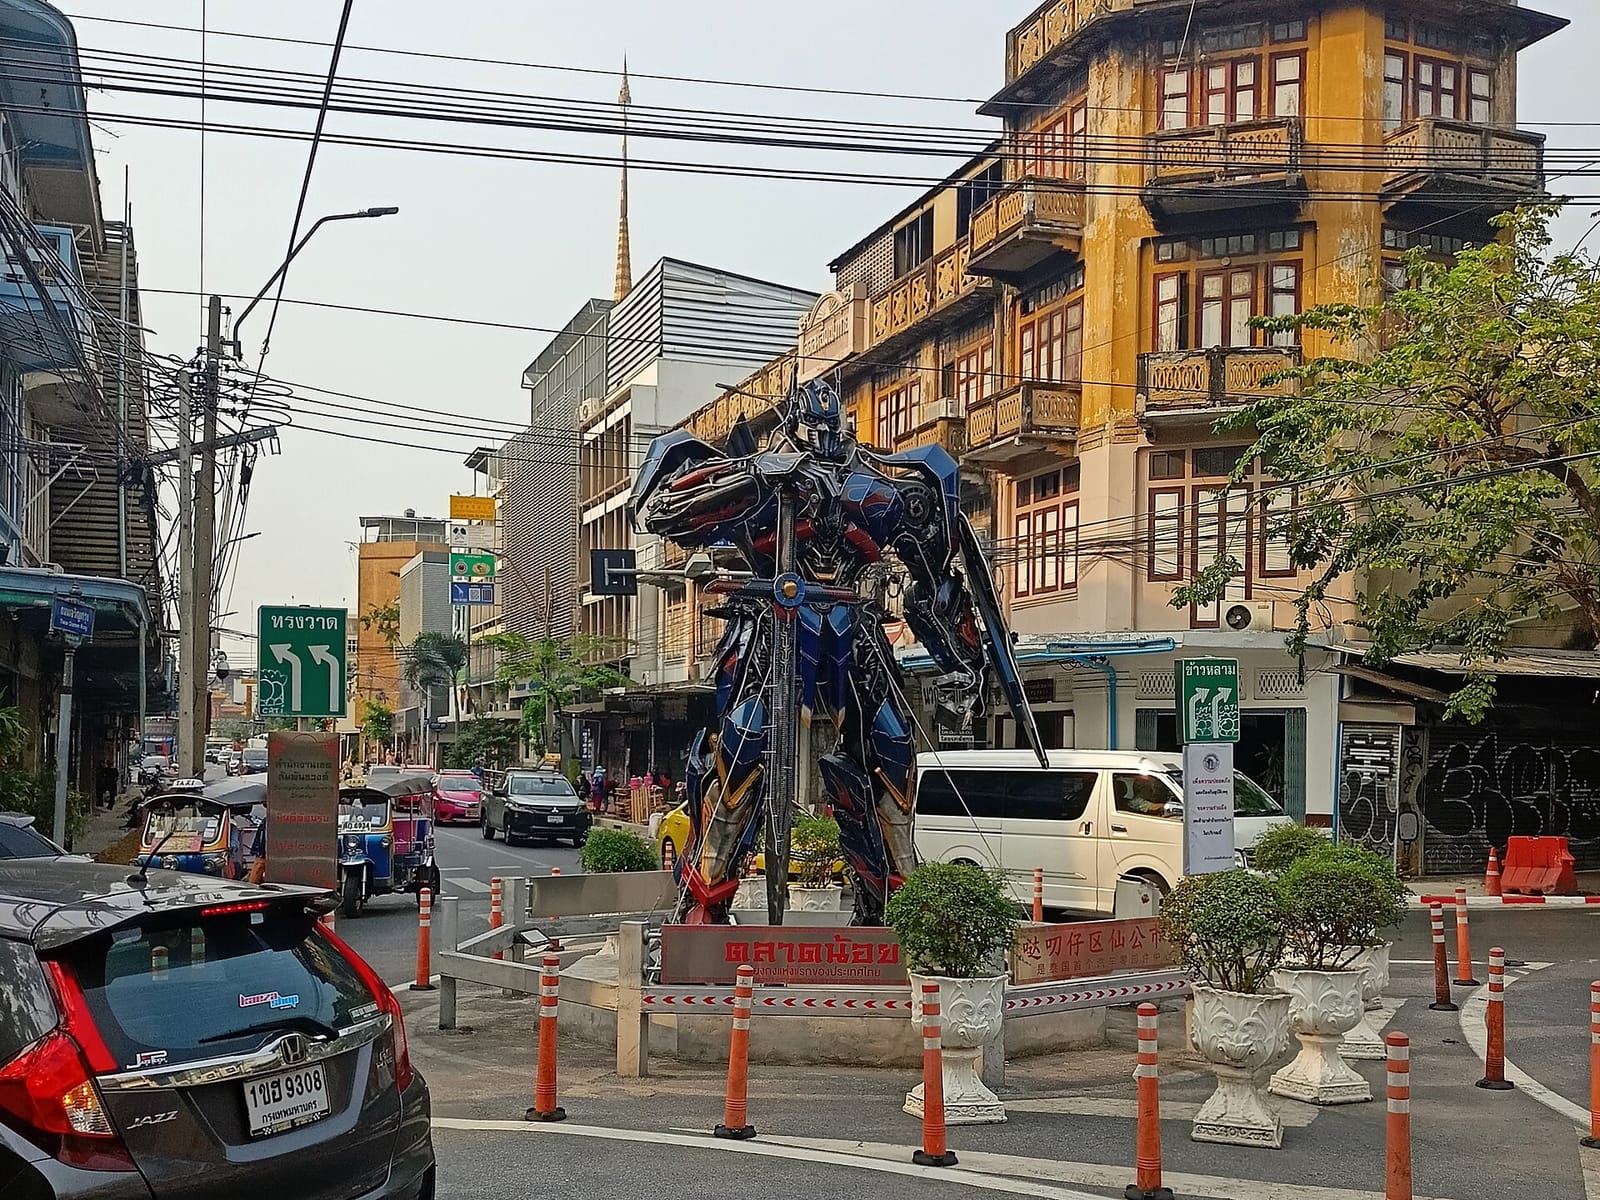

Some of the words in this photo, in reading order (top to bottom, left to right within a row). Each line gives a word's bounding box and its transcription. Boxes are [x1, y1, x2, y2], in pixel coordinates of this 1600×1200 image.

[271, 615, 338, 630] ทรงวาด
[1185, 661, 1236, 676] ข้าวหลาม
[724, 934, 900, 964] ตลาดน้อย
[753, 965, 881, 978] ยงกงแห่งแรกของประเทศไทย
[285, 1069, 322, 1098] 9308
[126, 1110, 179, 1130] JAZZ
